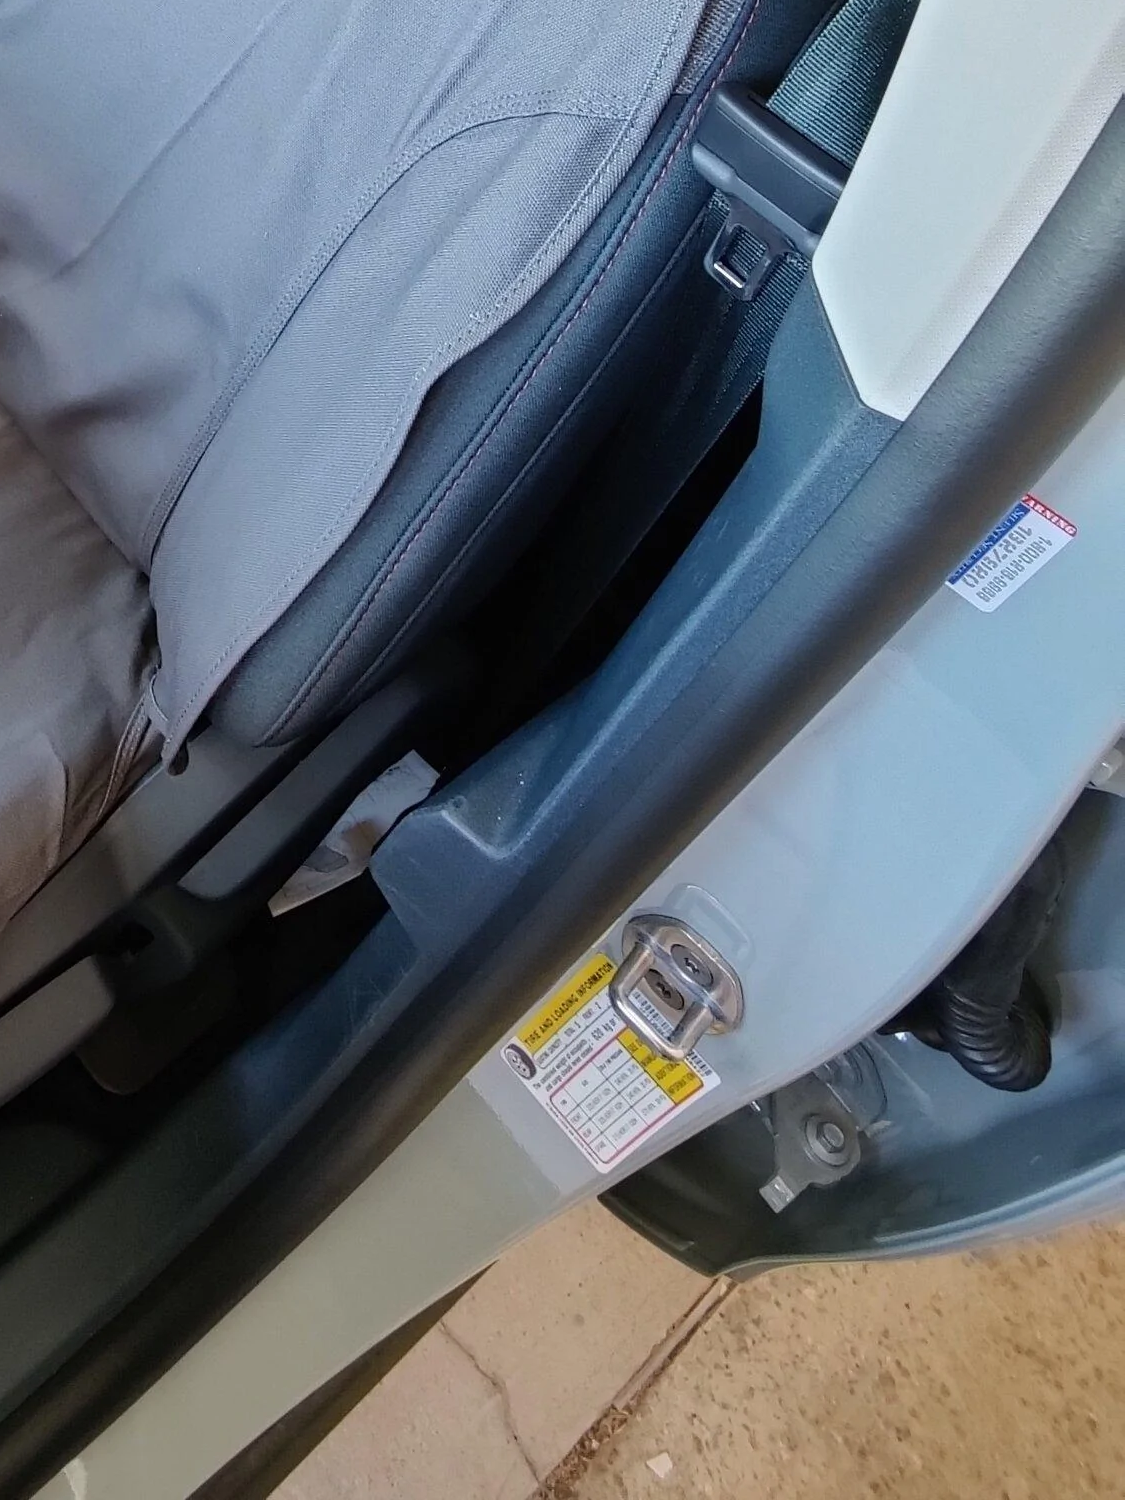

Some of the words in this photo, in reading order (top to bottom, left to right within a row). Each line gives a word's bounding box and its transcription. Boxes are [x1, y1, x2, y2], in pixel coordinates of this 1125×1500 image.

[524, 1030, 541, 1047] TIRE
[539, 1018, 554, 1033] AND
[551, 994, 579, 1022] LOADING
[575, 962, 613, 997] INFORMATION
